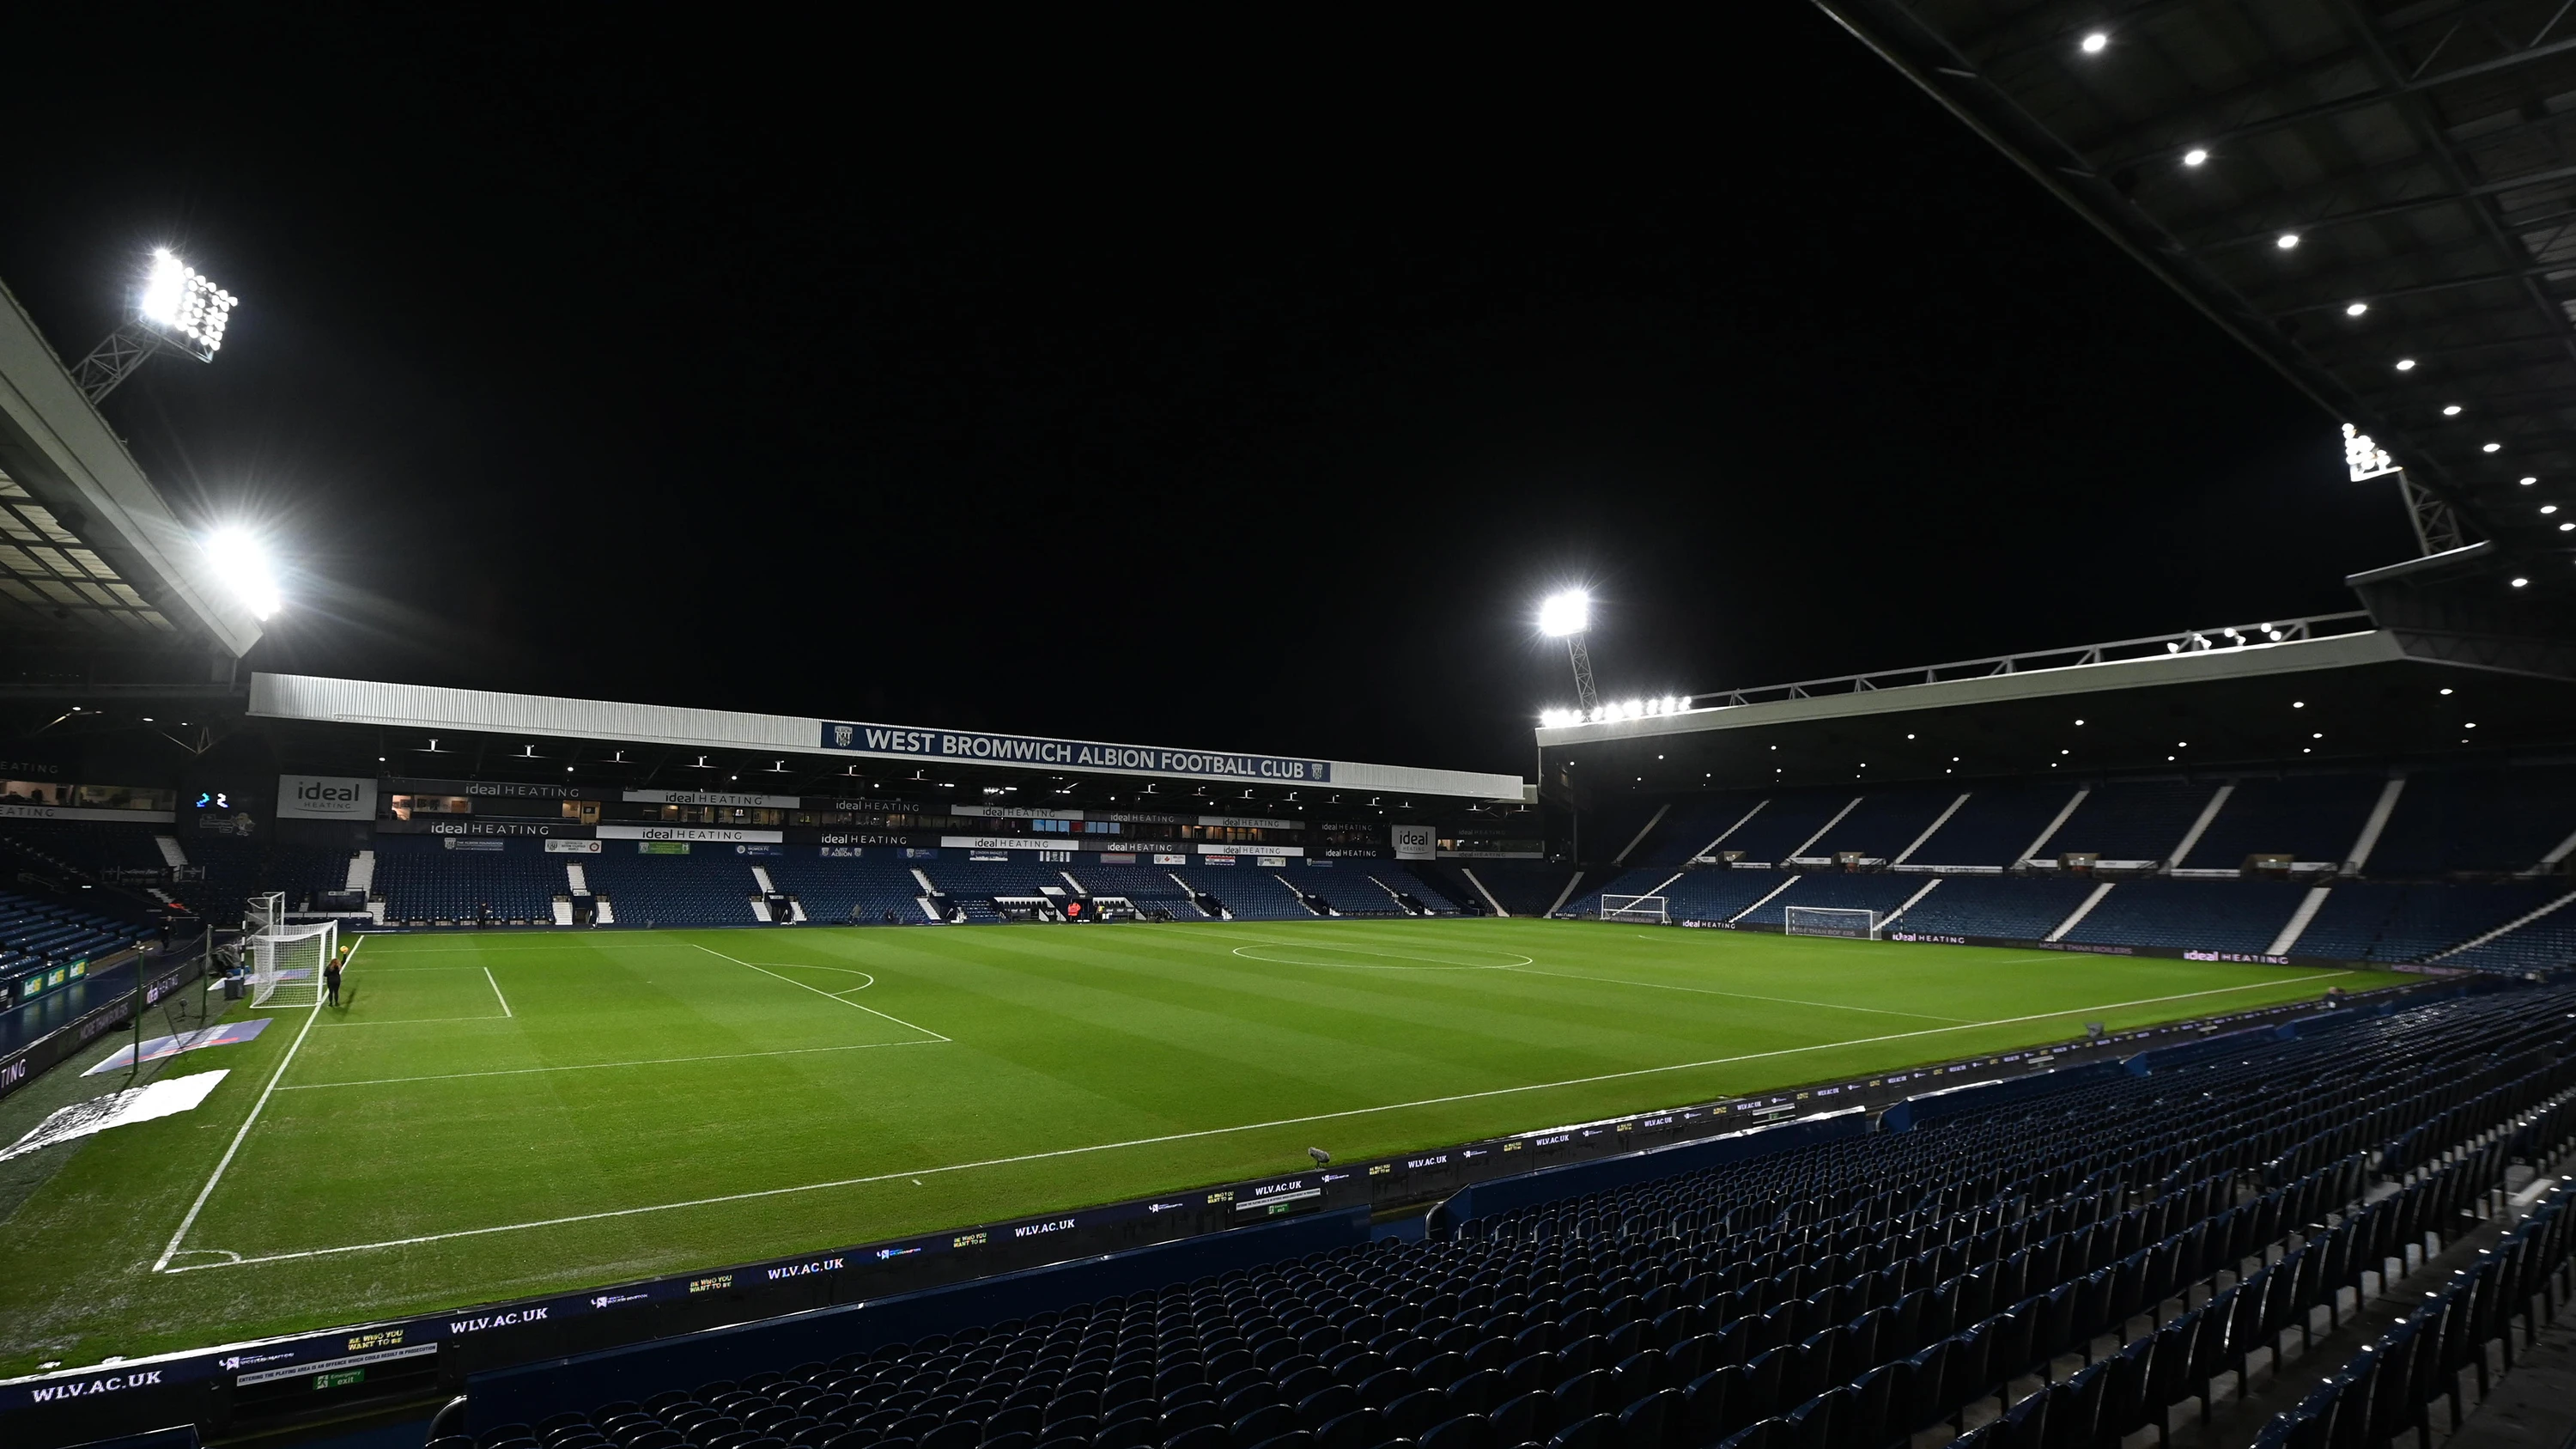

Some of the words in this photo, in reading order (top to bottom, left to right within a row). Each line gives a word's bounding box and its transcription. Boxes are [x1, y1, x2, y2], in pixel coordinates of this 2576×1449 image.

[866, 728, 935, 752] WEST
[942, 734, 1071, 763] BROMWICH
[1078, 746, 1155, 768] ALBION
[1161, 752, 1256, 775] FOOTBALL
[1261, 759, 1304, 778] CLUB
[1, 762, 58, 773] EATING
[298, 782, 360, 801] ideal
[465, 782, 500, 795] ideal
[505, 786, 580, 798] HEATING
[665, 792, 695, 803] ideal
[699, 795, 762, 805] HEATING
[835, 800, 862, 810] ideal
[865, 801, 920, 812] HEATING
[982, 807, 1005, 816] ideal
[1007, 809, 1055, 818] HEATING
[1110, 813, 1131, 822] ideal
[1133, 814, 1175, 823] HEATING
[1223, 818, 1240, 826] ideal
[431, 822, 467, 834] ideal
[471, 824, 550, 835] HEATING
[642, 829, 673, 839] ideal
[677, 831, 742, 840] HEATING
[821, 833, 848, 844] ideal
[850, 835, 907, 845] HEATING
[975, 838, 998, 848] ideal
[999, 839, 1048, 849] HEATING
[1400, 831, 1428, 845] ideal
[1107, 843, 1127, 851] ideal
[1129, 843, 1172, 852] HEATING
[1683, 919, 1700, 928] ideal
[1893, 932, 1917, 941] ideal
[1918, 935, 1965, 944] HEATING
[2184, 950, 2219, 961] ideal
[2221, 953, 2289, 965] HEATING
[1, 1058, 26, 1088] TING
[1644, 1117, 1673, 1127] WLV.AC.UK
[1536, 1134, 1570, 1147] WLV.AC.UK
[1408, 1154, 1447, 1169] WLV.AC.UK
[1255, 1181, 1302, 1196] WLV.AC.UK
[1015, 1219, 1075, 1238] WLV.AC.UK
[768, 1257, 844, 1280] WLV.AC.UK
[450, 1306, 549, 1334] WLV.AC.UK
[363, 1332, 383, 1342] WHO
[386, 1330, 404, 1338] YOU
[348, 1341, 375, 1351] WANT
[239, 1374, 264, 1383] ENTERING
[404, 1345, 435, 1355] PROSECUTION
[31, 1370, 163, 1403] WLV.AC.UK
[337, 1376, 354, 1385] exit
